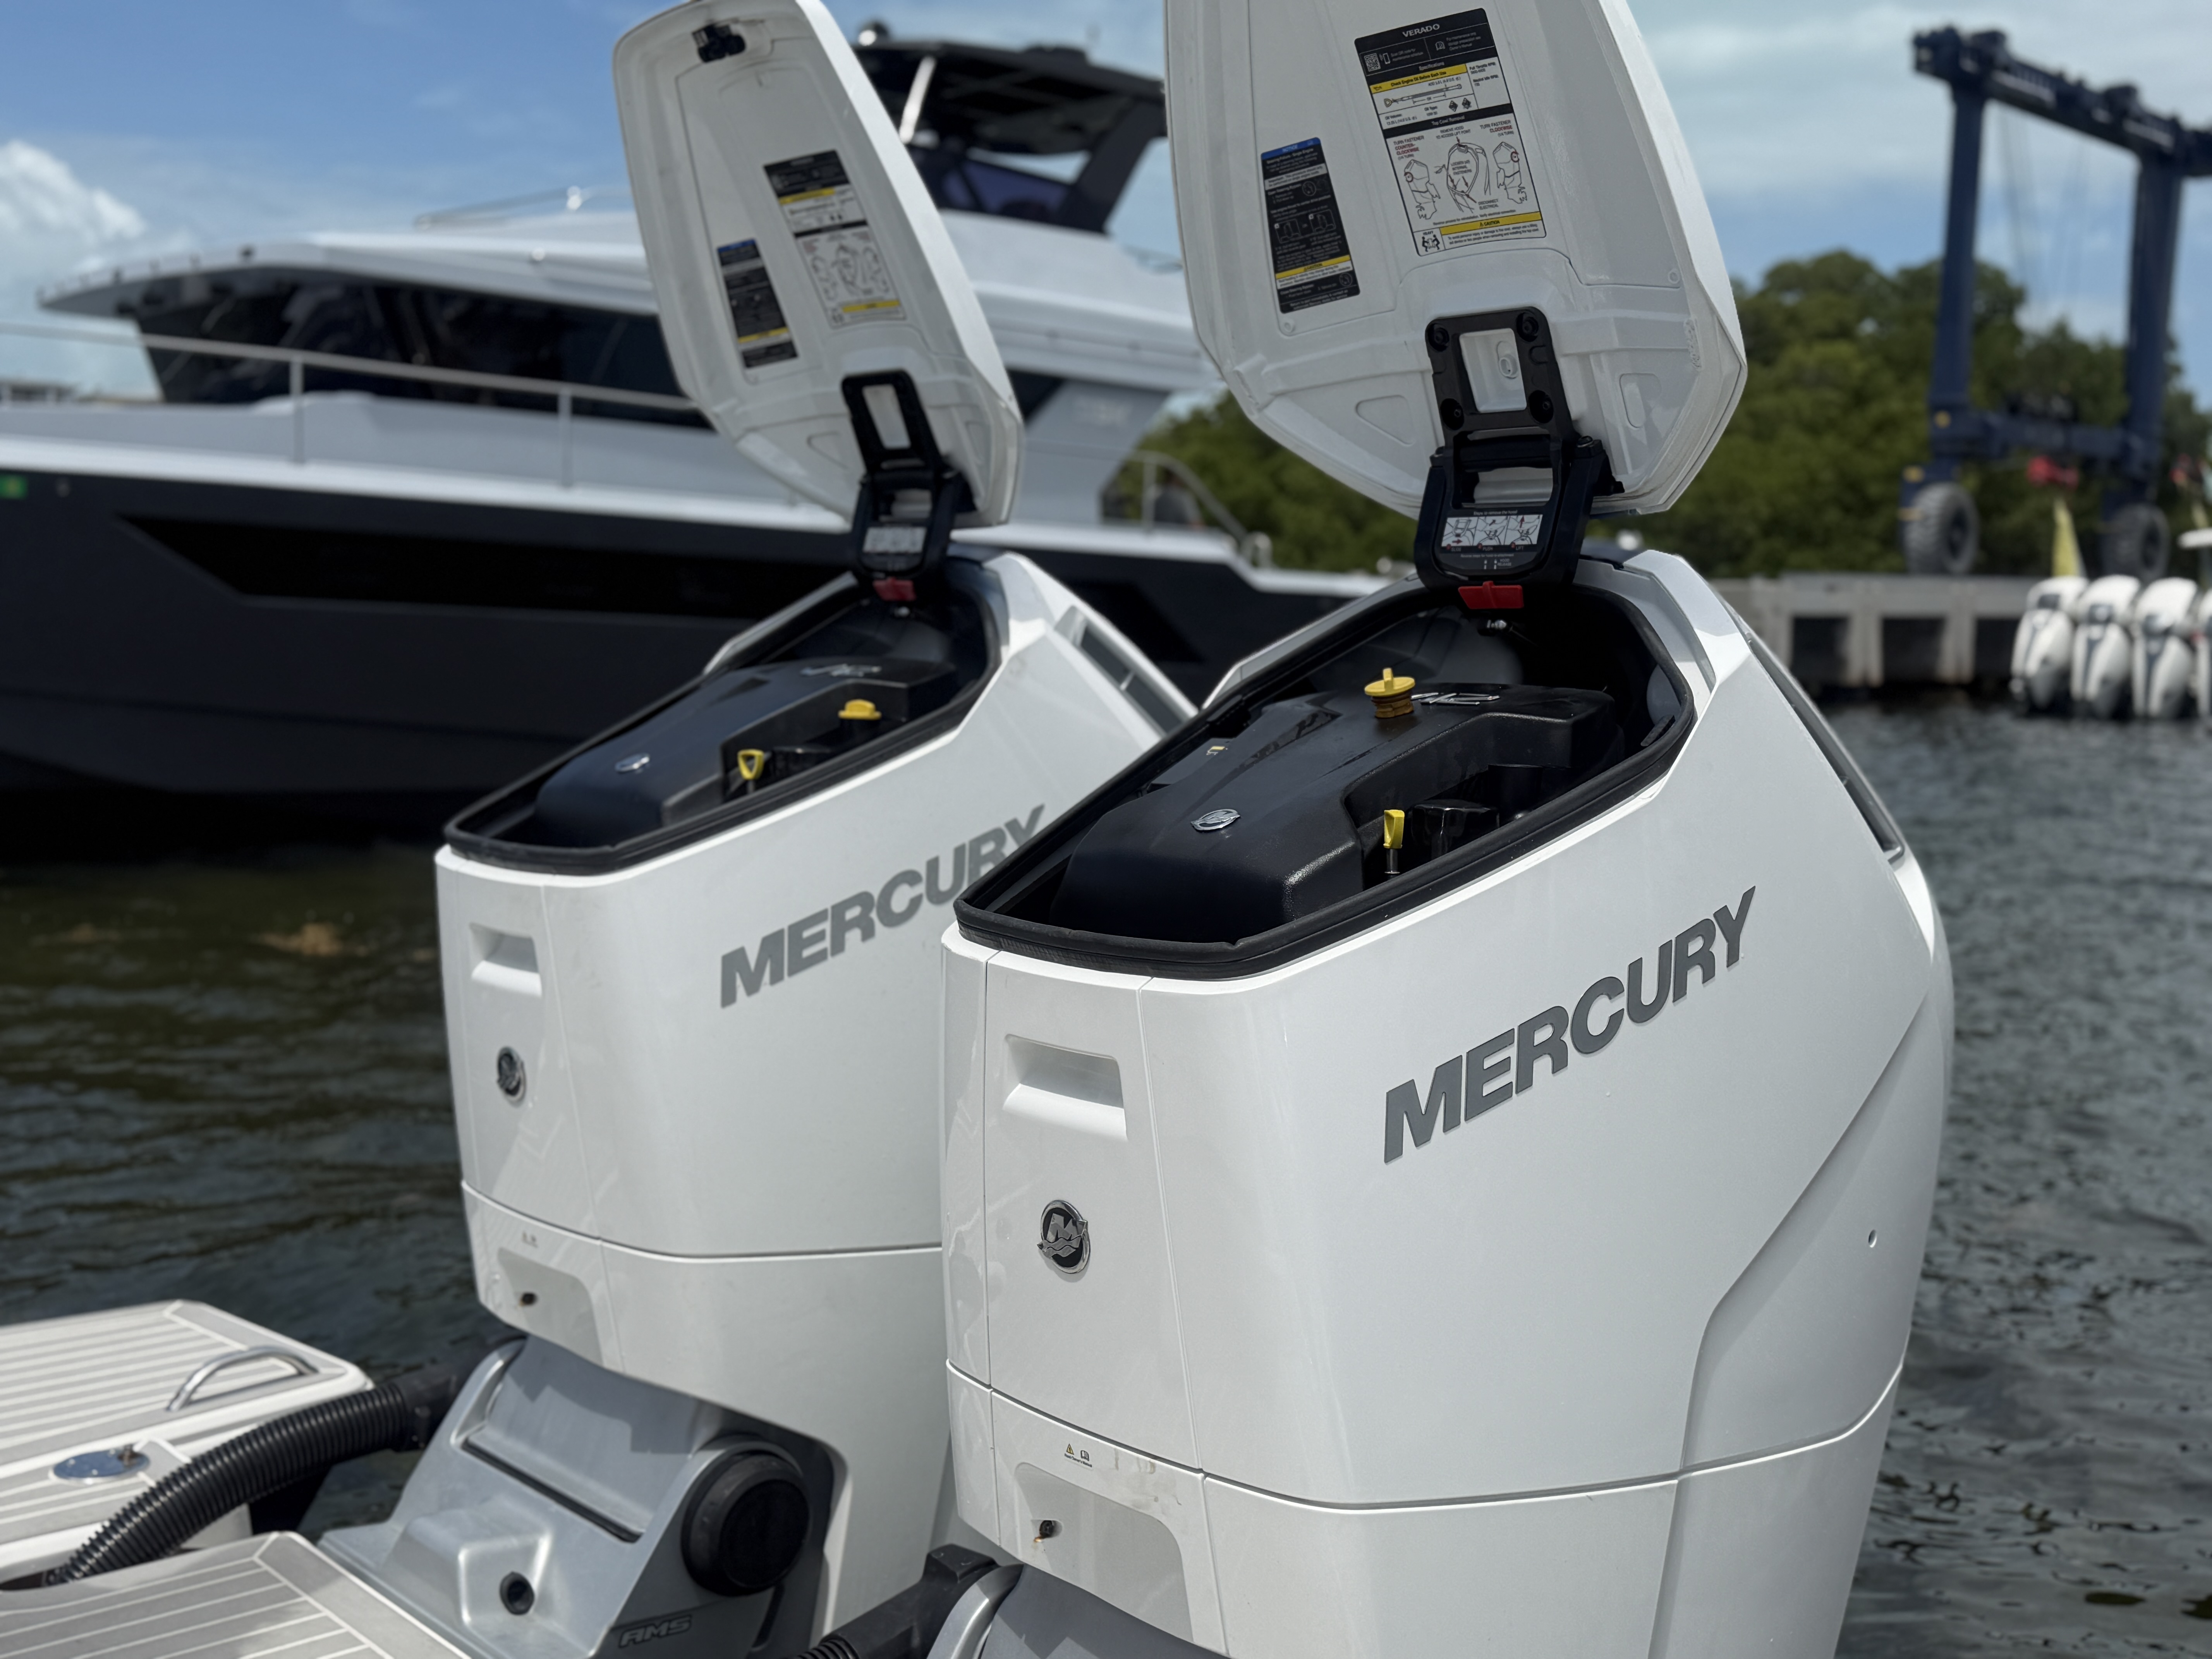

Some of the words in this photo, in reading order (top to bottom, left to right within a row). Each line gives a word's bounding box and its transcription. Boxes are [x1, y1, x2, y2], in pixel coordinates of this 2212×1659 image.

[1402, 23, 1441, 37] VERADO
[1419, 61, 1444, 70] Specifications
[1489, 124, 1513, 133] CLOCKWISE
[1396, 147, 1419, 155] CLOCKWISE
[721, 804, 1045, 1009] MERCURY
[1384, 885, 1756, 1163] MERCURY
[620, 1615, 692, 1648] AMS
